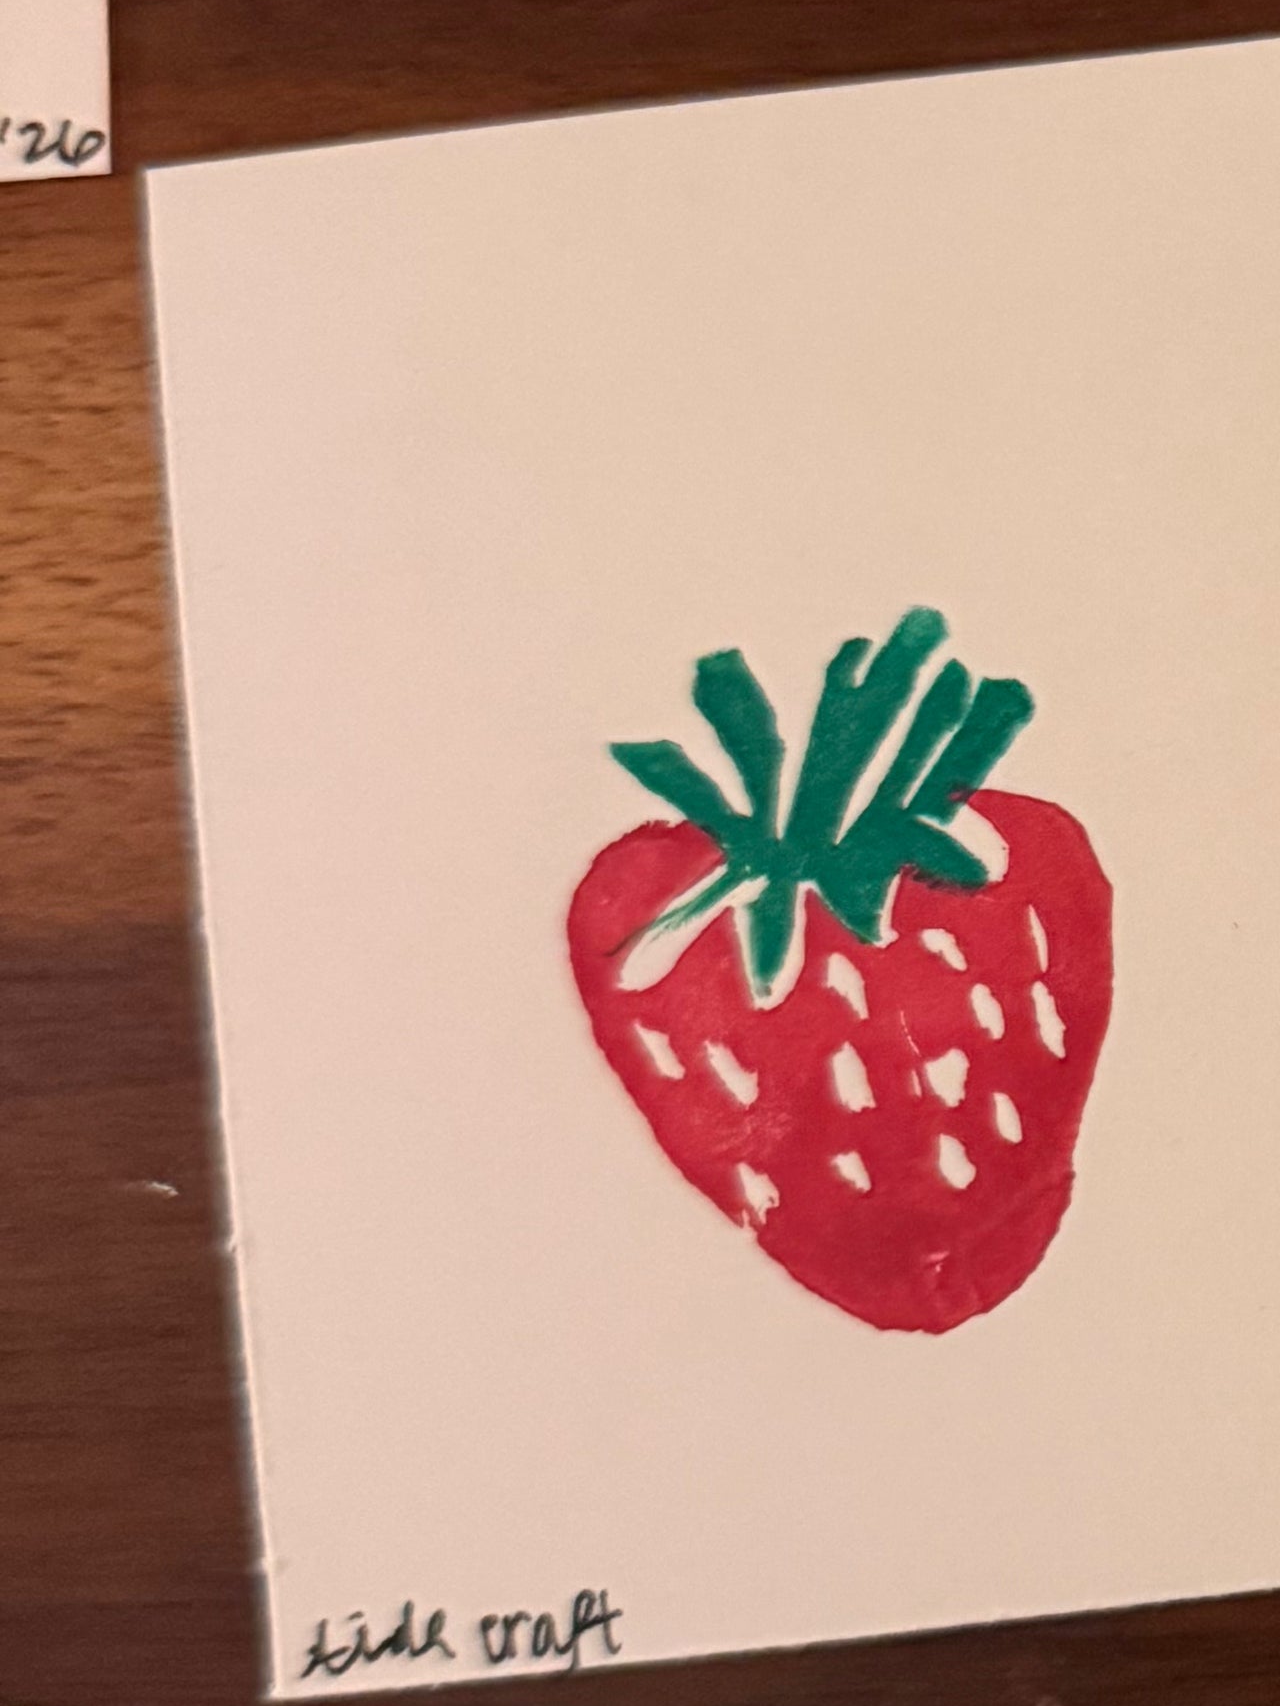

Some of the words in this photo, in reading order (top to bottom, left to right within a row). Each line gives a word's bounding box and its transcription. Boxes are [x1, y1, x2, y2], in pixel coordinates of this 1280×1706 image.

[0, 116, 106, 168] '26
[300, 1598, 456, 1679] tide
[480, 1588, 624, 1676] craft
